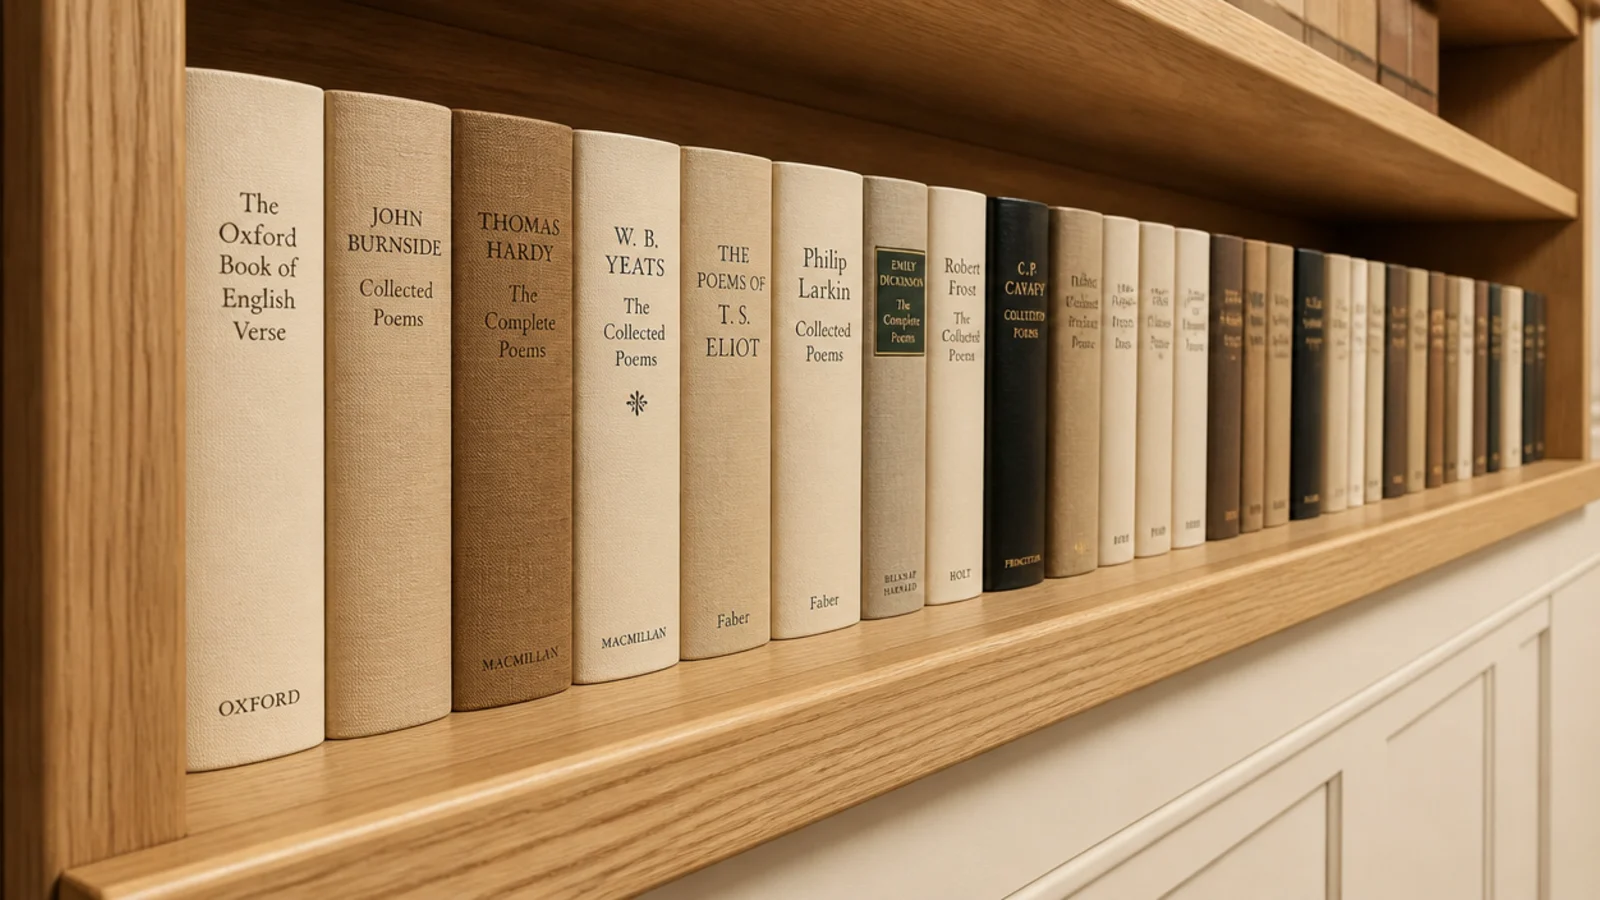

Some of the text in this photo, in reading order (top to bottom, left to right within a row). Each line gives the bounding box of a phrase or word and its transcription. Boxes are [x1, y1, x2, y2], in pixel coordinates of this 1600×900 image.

[240, 192, 279, 215] The
[371, 207, 423, 228] JOHN
[477, 212, 560, 236] THOMAS
[219, 222, 296, 247] Oxford
[615, 226, 658, 248] W. B.
[348, 234, 441, 256] BURNSIDE
[487, 241, 554, 262] HARDY
[718, 245, 749, 263] THE
[219, 255, 299, 278] Book of
[606, 255, 664, 276] YEATS
[803, 248, 847, 275] Philip
[944, 258, 980, 275] Robert
[360, 279, 433, 299] Collected
[698, 272, 766, 291] POEMS OF
[799, 278, 850, 300] Larkin
[948, 280, 976, 296] Frost
[222, 288, 295, 314] English
[509, 285, 537, 303] The
[624, 298, 650, 315] The
[718, 305, 750, 325] T. S.
[374, 309, 423, 327] Poems
[485, 312, 555, 335] Complete
[953, 312, 970, 324] The
[233, 321, 286, 341] Verse
[604, 323, 665, 341] Collected
[795, 321, 851, 338] Collected
[499, 340, 546, 358] Poems
[706, 338, 760, 357] ELIOT
[806, 346, 843, 362] Poems
[615, 350, 657, 366] Poems
[950, 569, 971, 581] HOLT
[810, 594, 840, 610] Faber
[717, 610, 750, 629] Faber
[601, 626, 667, 650] MACMILLAN
[482, 647, 560, 672] MACMILLAN
[219, 689, 300, 717] OXFORD
